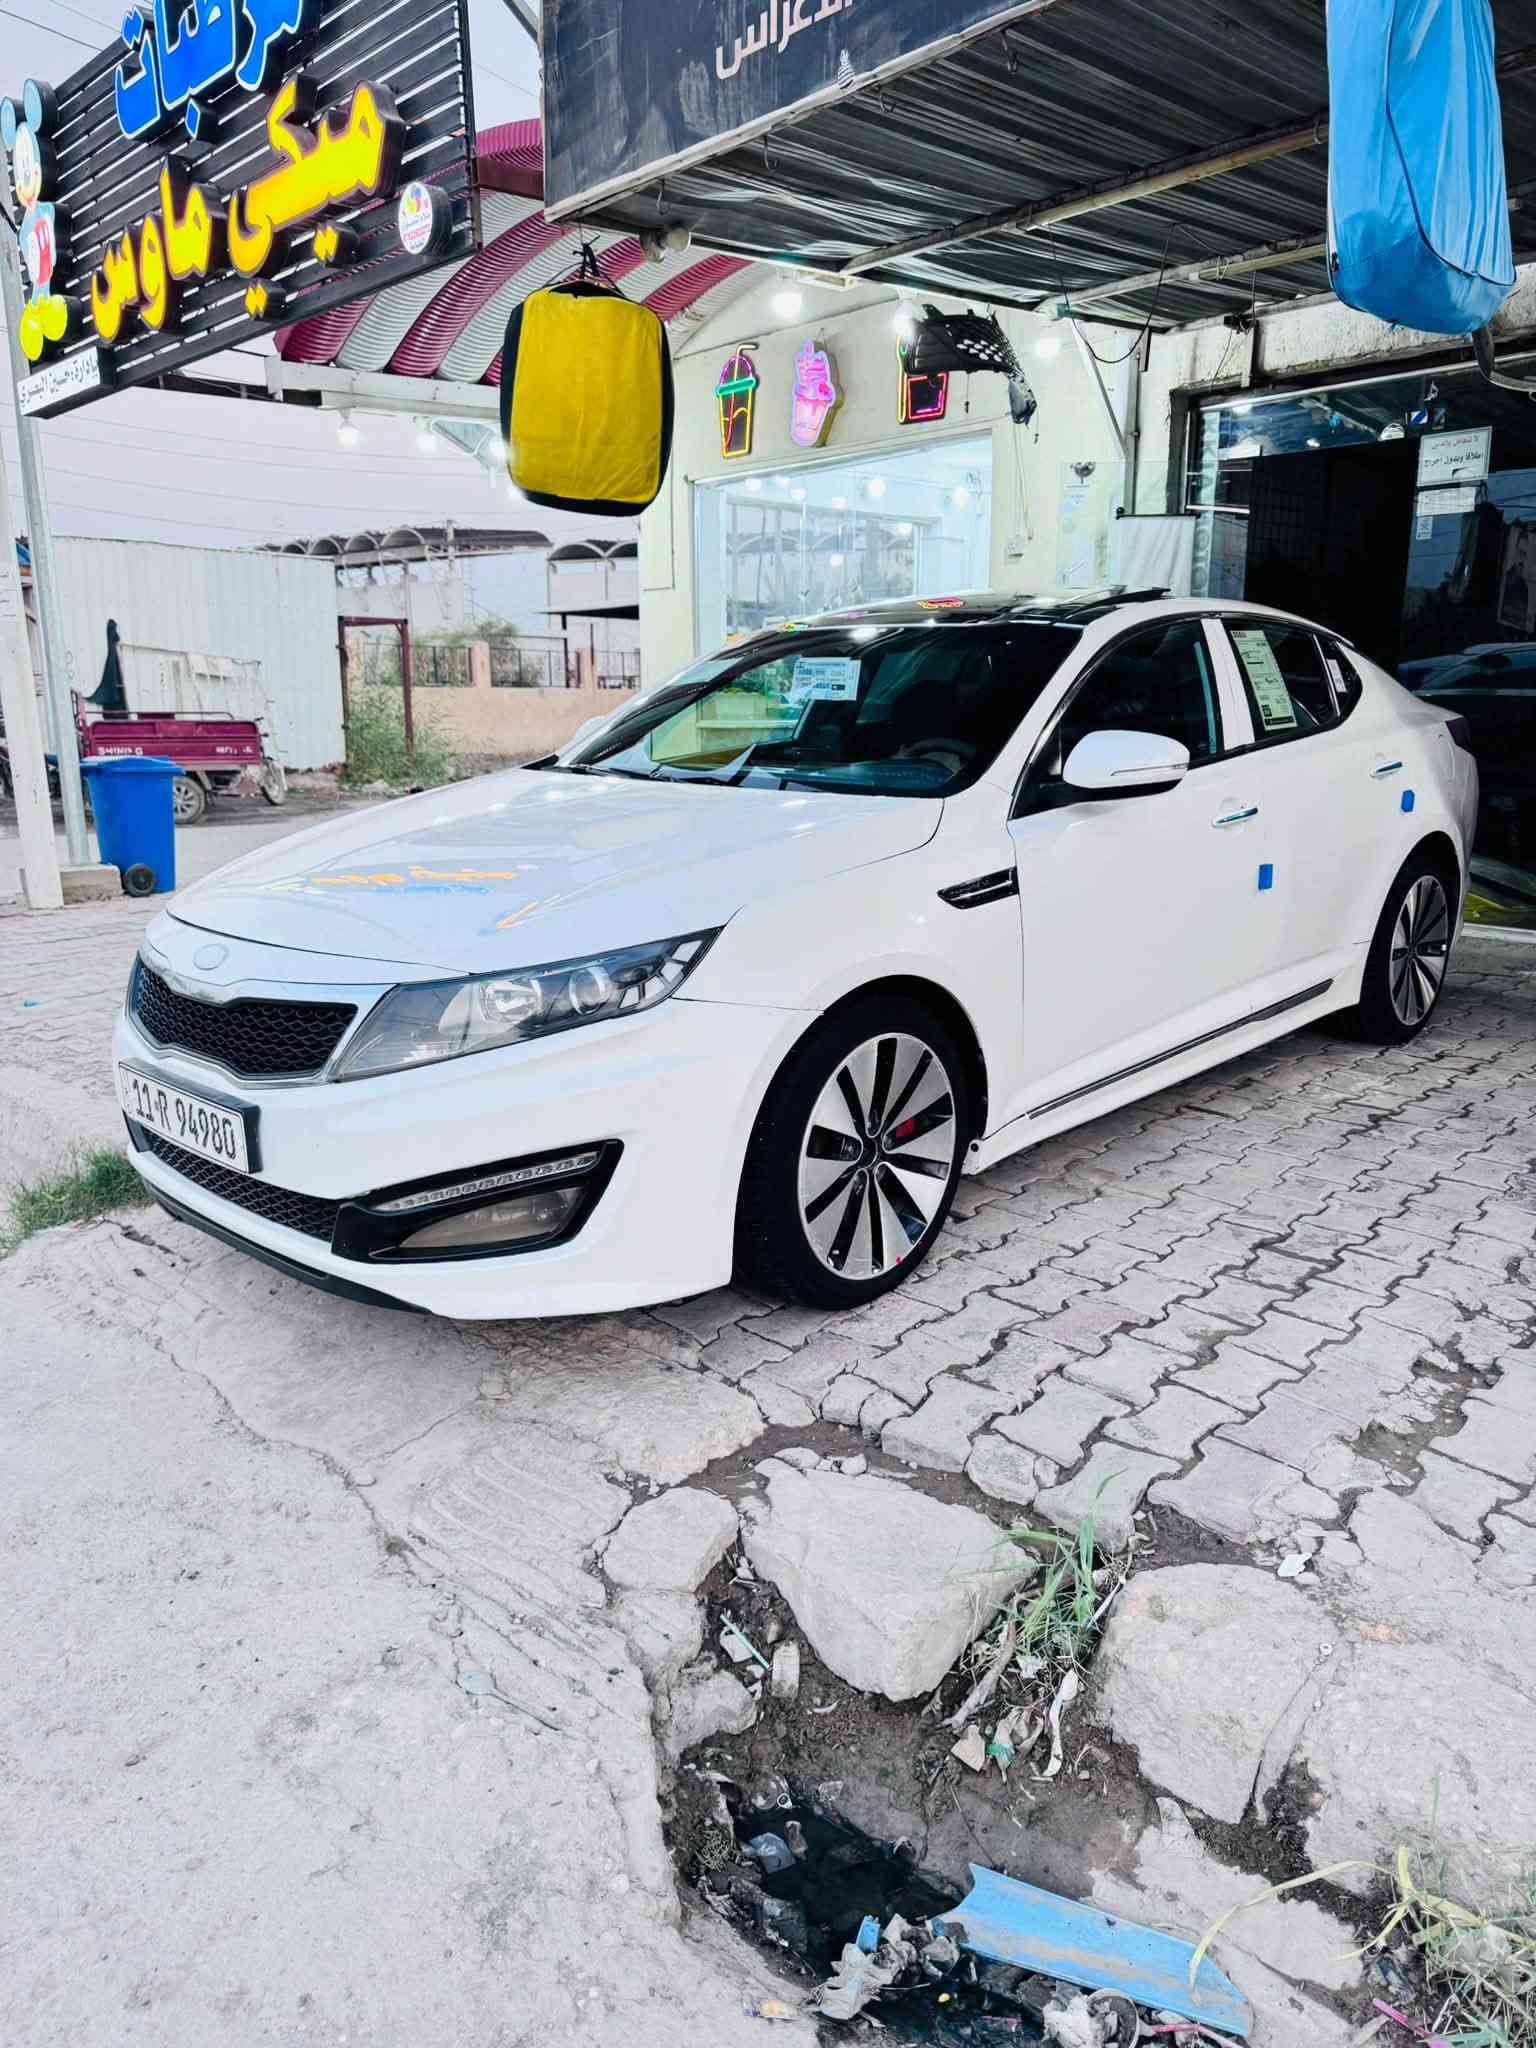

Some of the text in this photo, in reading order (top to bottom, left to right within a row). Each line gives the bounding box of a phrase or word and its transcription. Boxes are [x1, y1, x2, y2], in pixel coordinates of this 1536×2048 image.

[715, 0, 853, 80] عراس
[91, 77, 387, 343] ميكي ماوس
[175, 1101, 237, 1160] 94980
